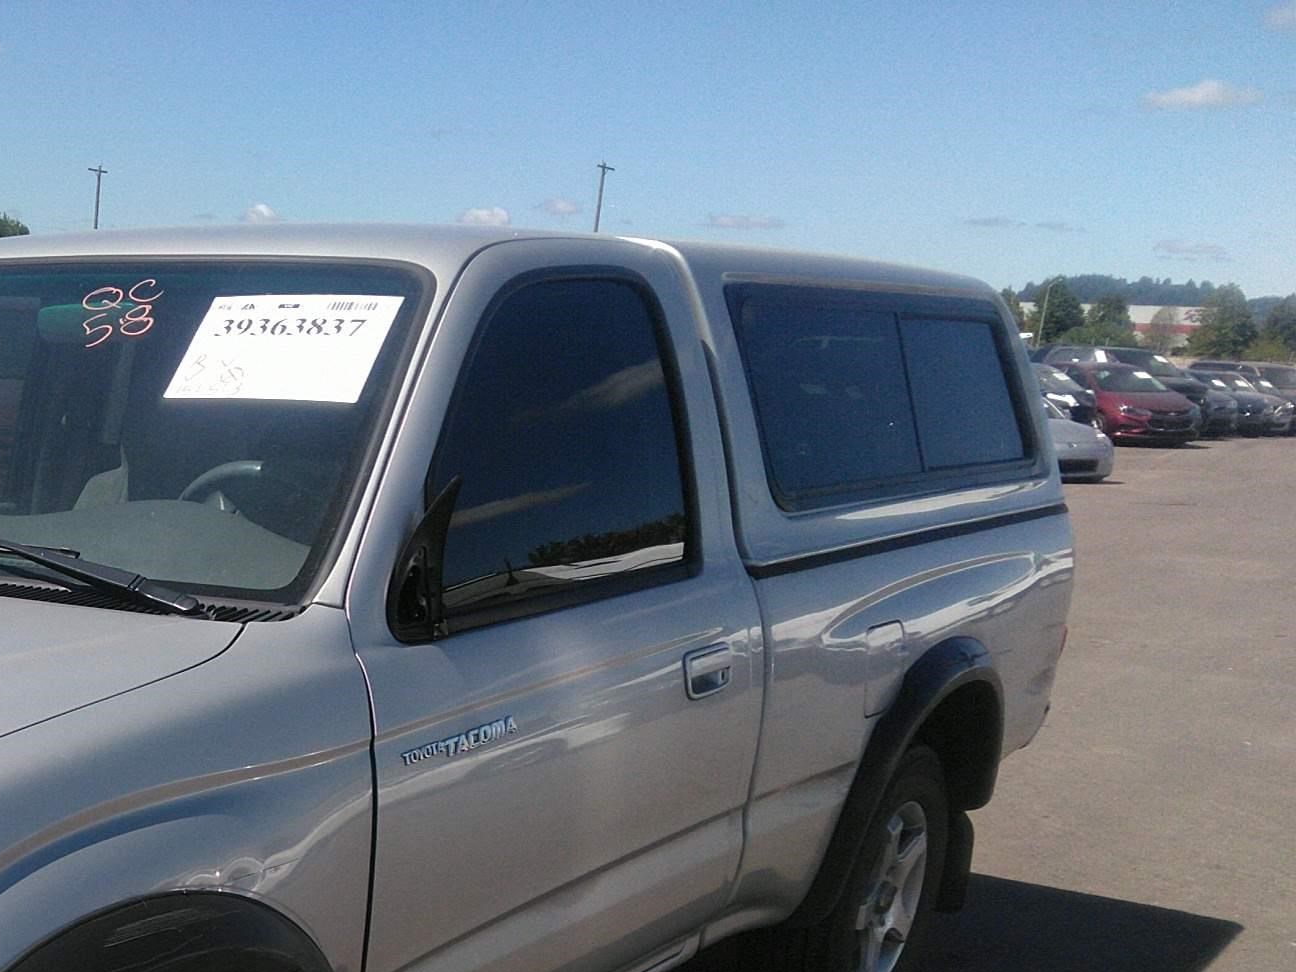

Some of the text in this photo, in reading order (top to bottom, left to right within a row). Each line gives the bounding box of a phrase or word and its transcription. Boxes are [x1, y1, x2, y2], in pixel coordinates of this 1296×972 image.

[212, 318, 367, 338] 39363837
[402, 714, 520, 767] TOYOTA TACOMA
